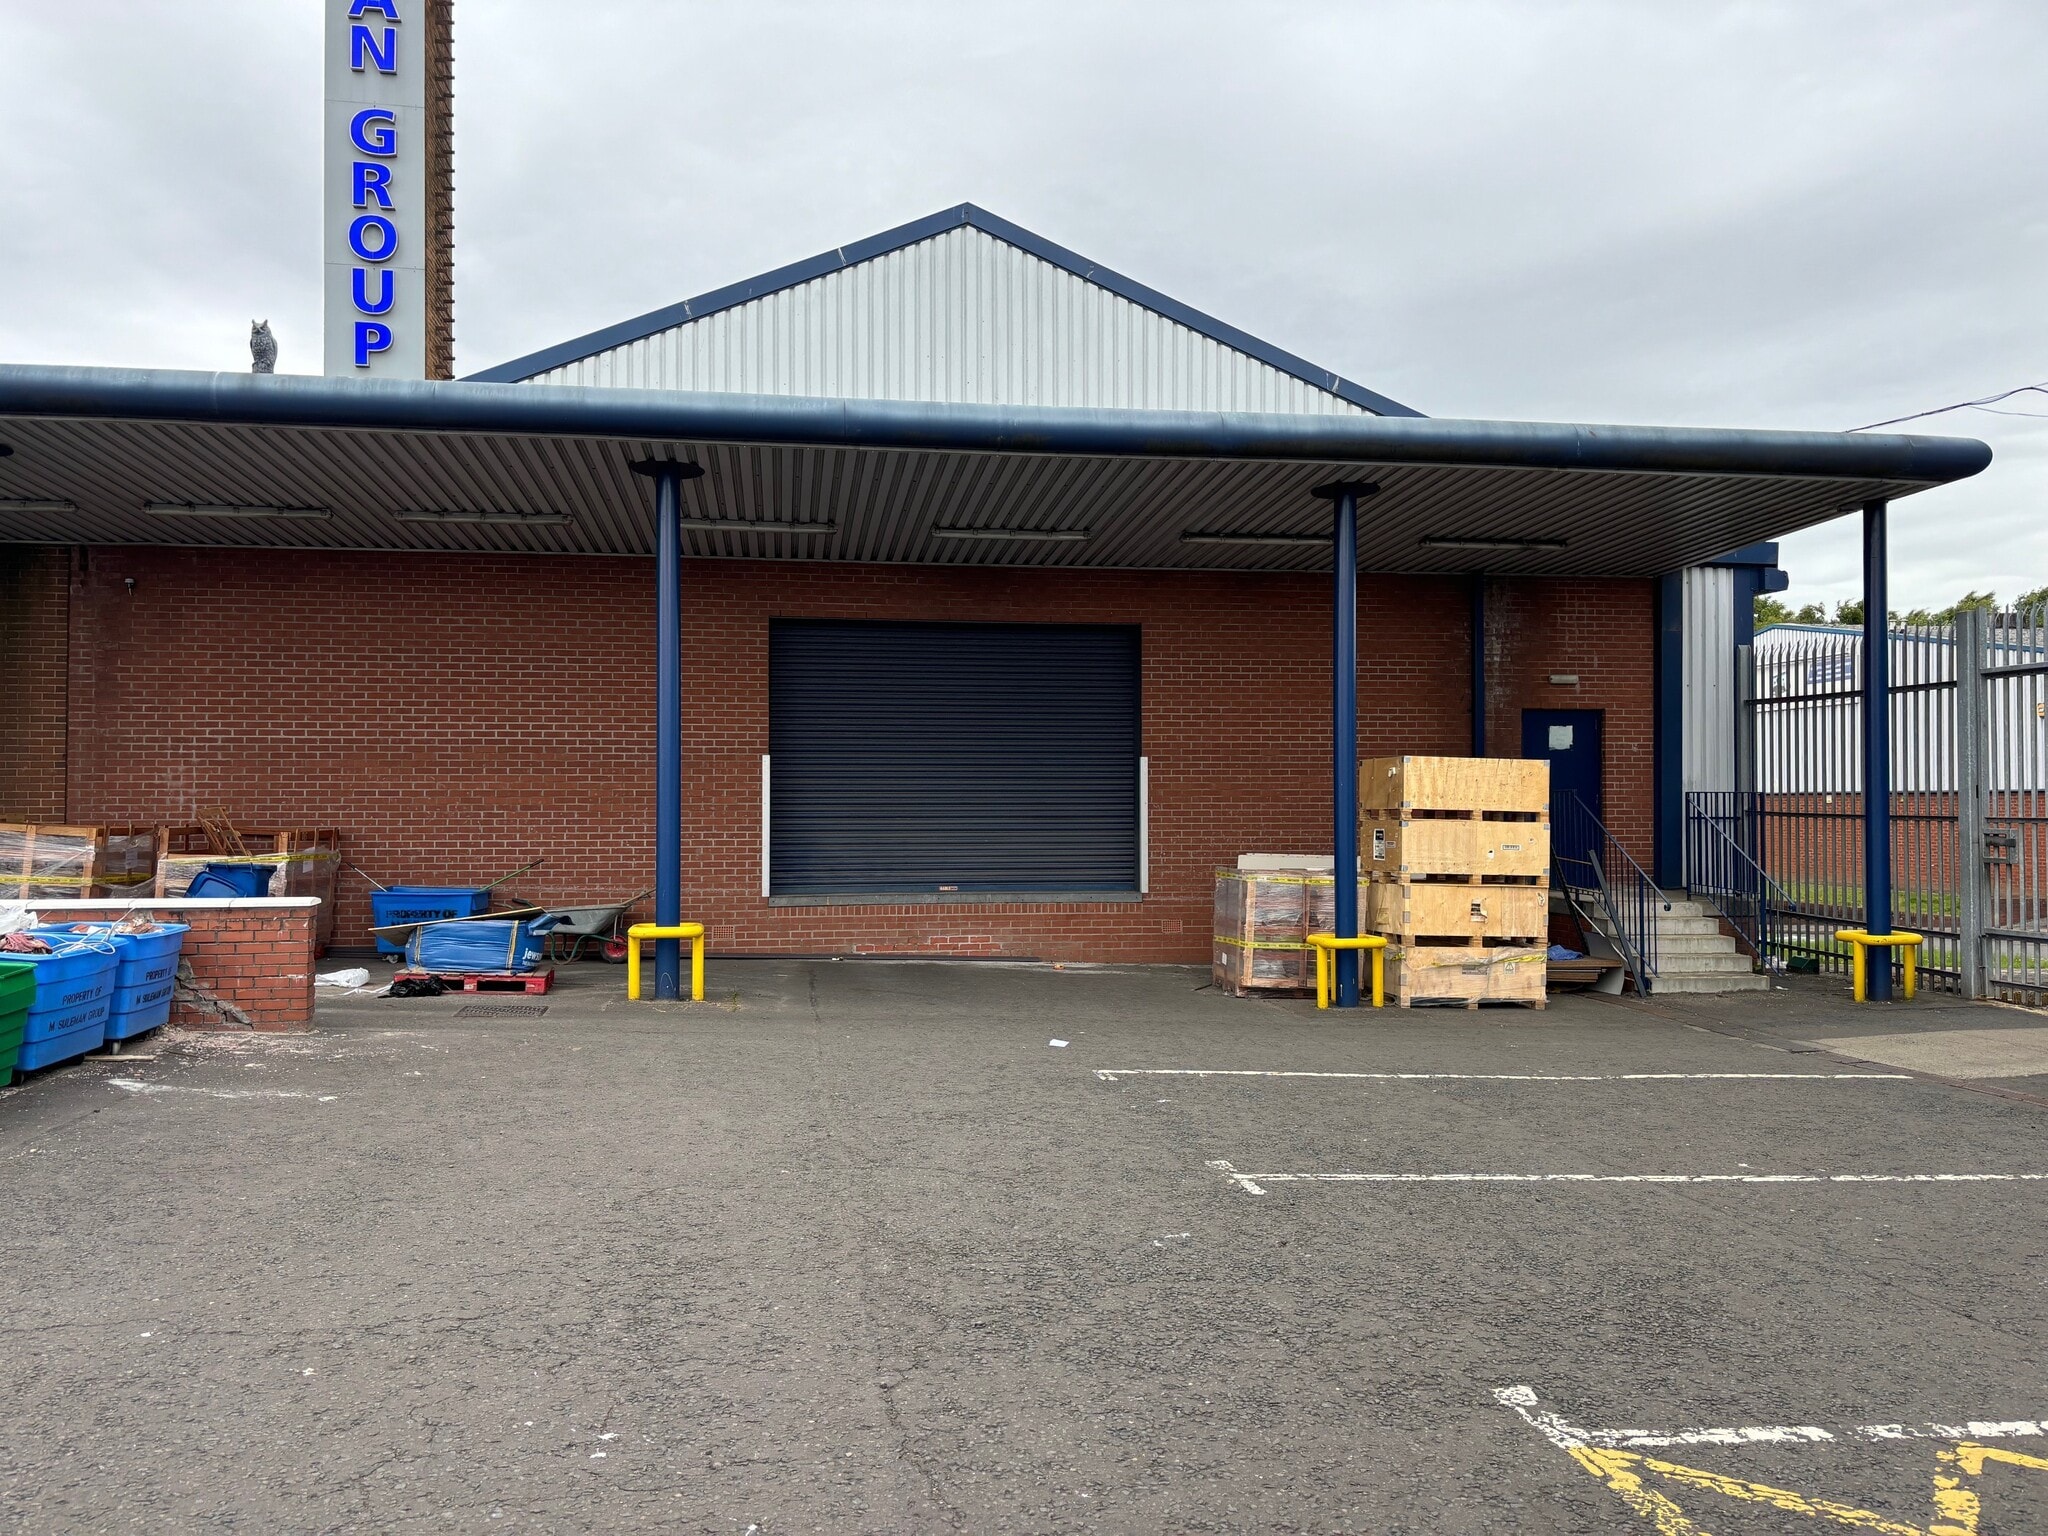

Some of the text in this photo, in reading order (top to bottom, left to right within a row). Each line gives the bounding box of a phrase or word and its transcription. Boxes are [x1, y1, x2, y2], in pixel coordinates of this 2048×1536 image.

[348, 108, 399, 367] GROUP
[443, 909, 458, 919] OF
[146, 969, 168, 981] PROPERTY
[62, 986, 103, 1005] PROPERTY OF
[49, 1006, 105, 1032] M SULEMAN GROUP
